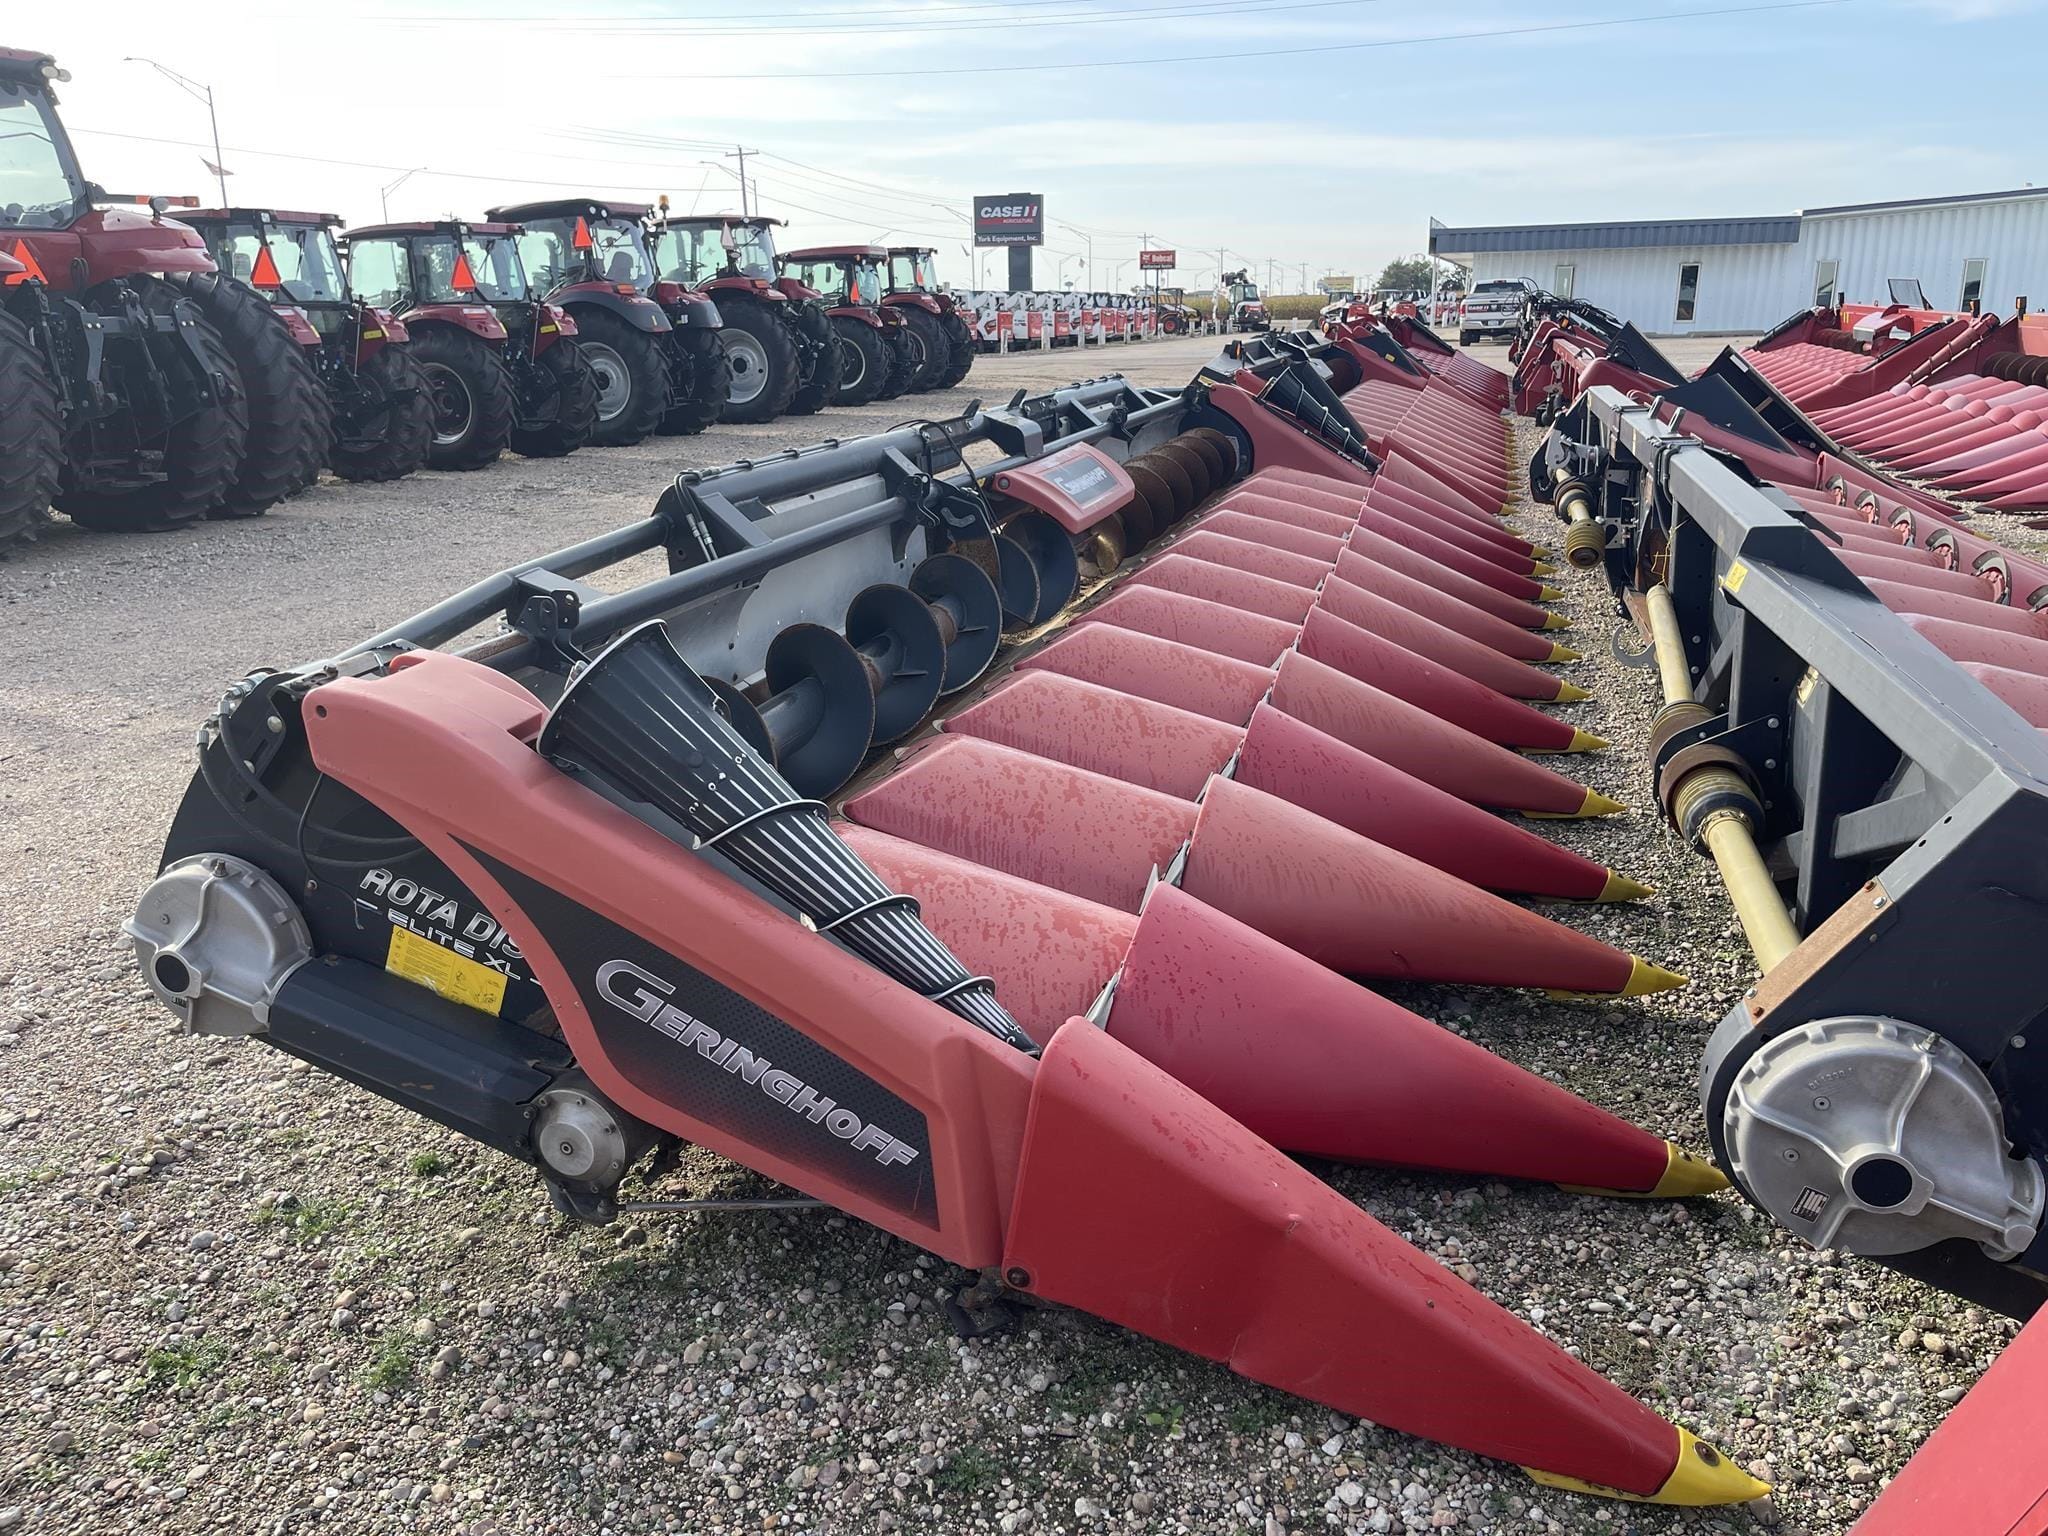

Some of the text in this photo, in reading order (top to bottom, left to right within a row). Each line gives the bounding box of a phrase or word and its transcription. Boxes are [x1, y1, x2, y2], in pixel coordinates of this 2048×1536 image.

[981, 206, 1022, 218] CASE
[992, 235, 1026, 243] Equipment,
[1152, 254, 1172, 262] Bobcat
[360, 868, 459, 930] ROTA
[387, 908, 476, 959] ELITE
[483, 952, 521, 980] XL
[595, 959, 920, 1167] GERINGHOFF
